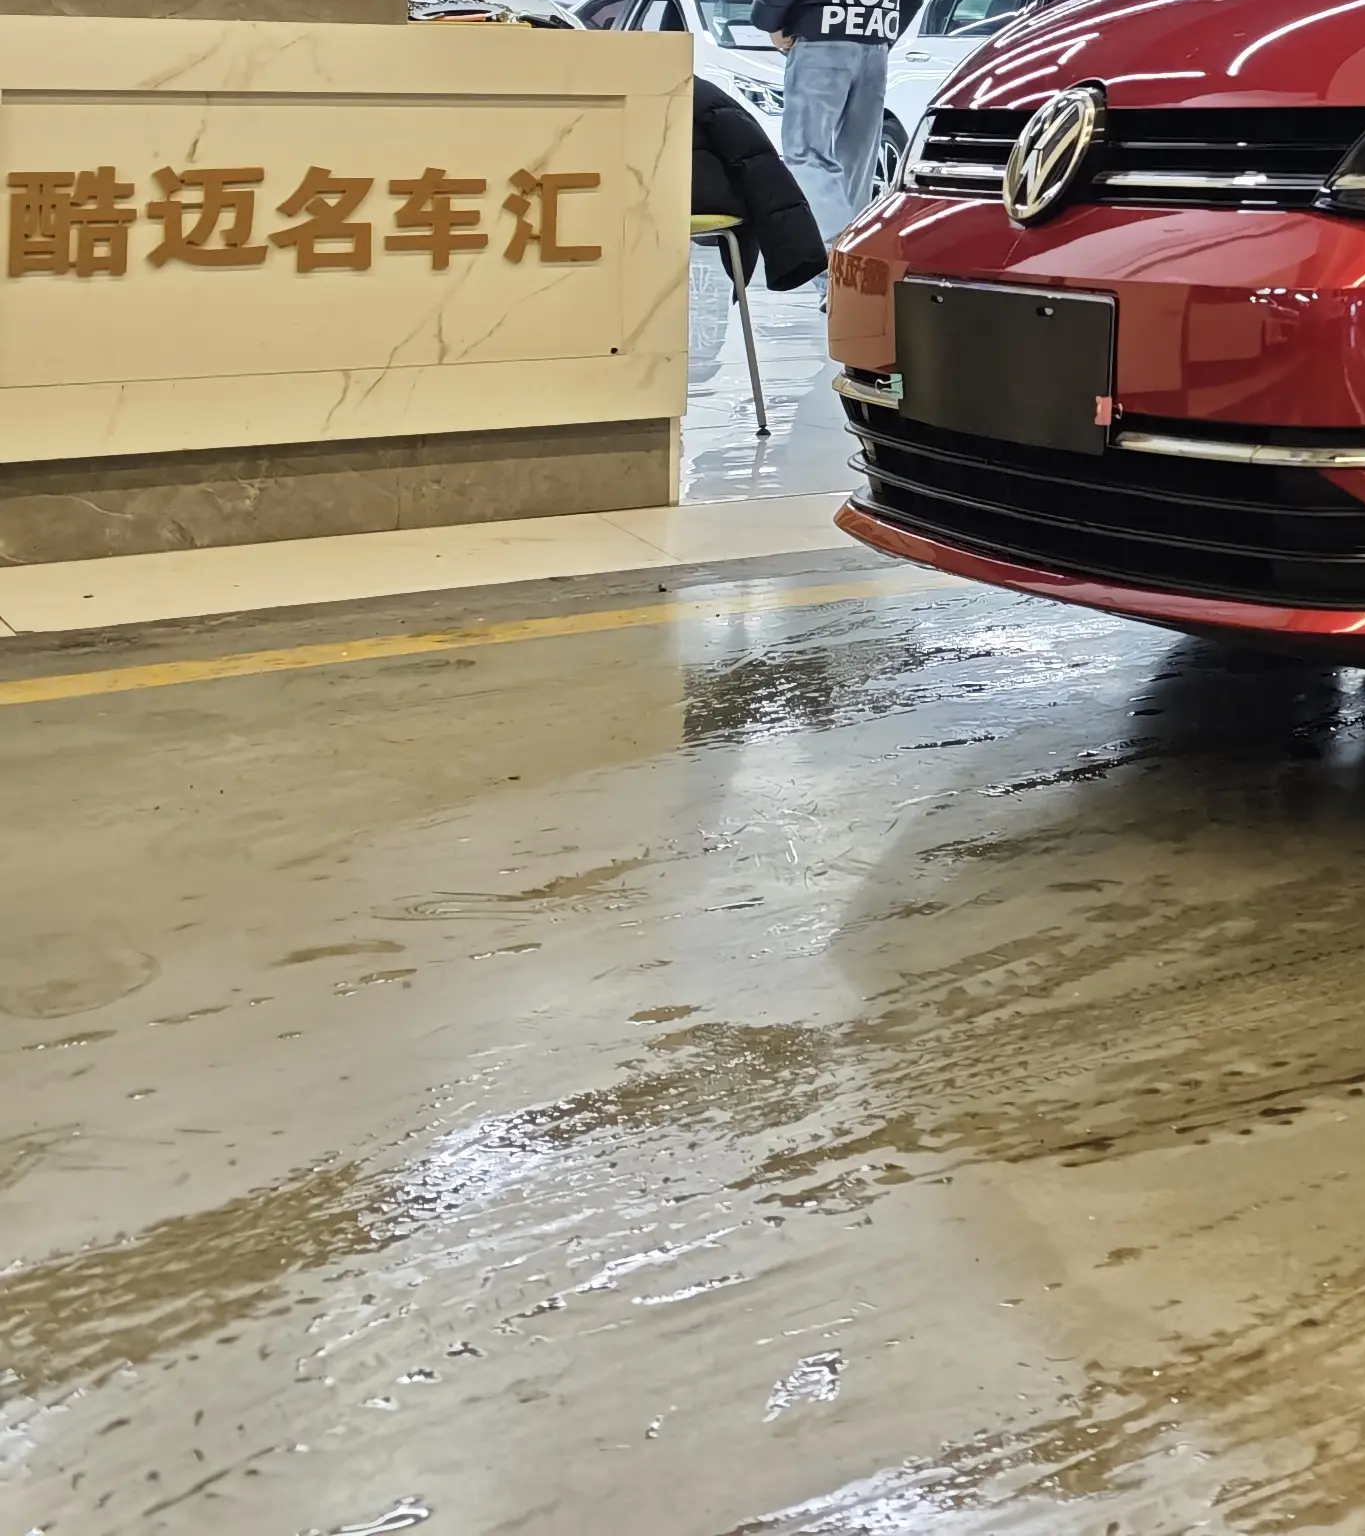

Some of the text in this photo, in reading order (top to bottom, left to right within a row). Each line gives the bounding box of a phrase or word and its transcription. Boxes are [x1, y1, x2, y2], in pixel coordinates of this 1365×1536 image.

[6, 165, 606, 279] 酷迈名车汇
